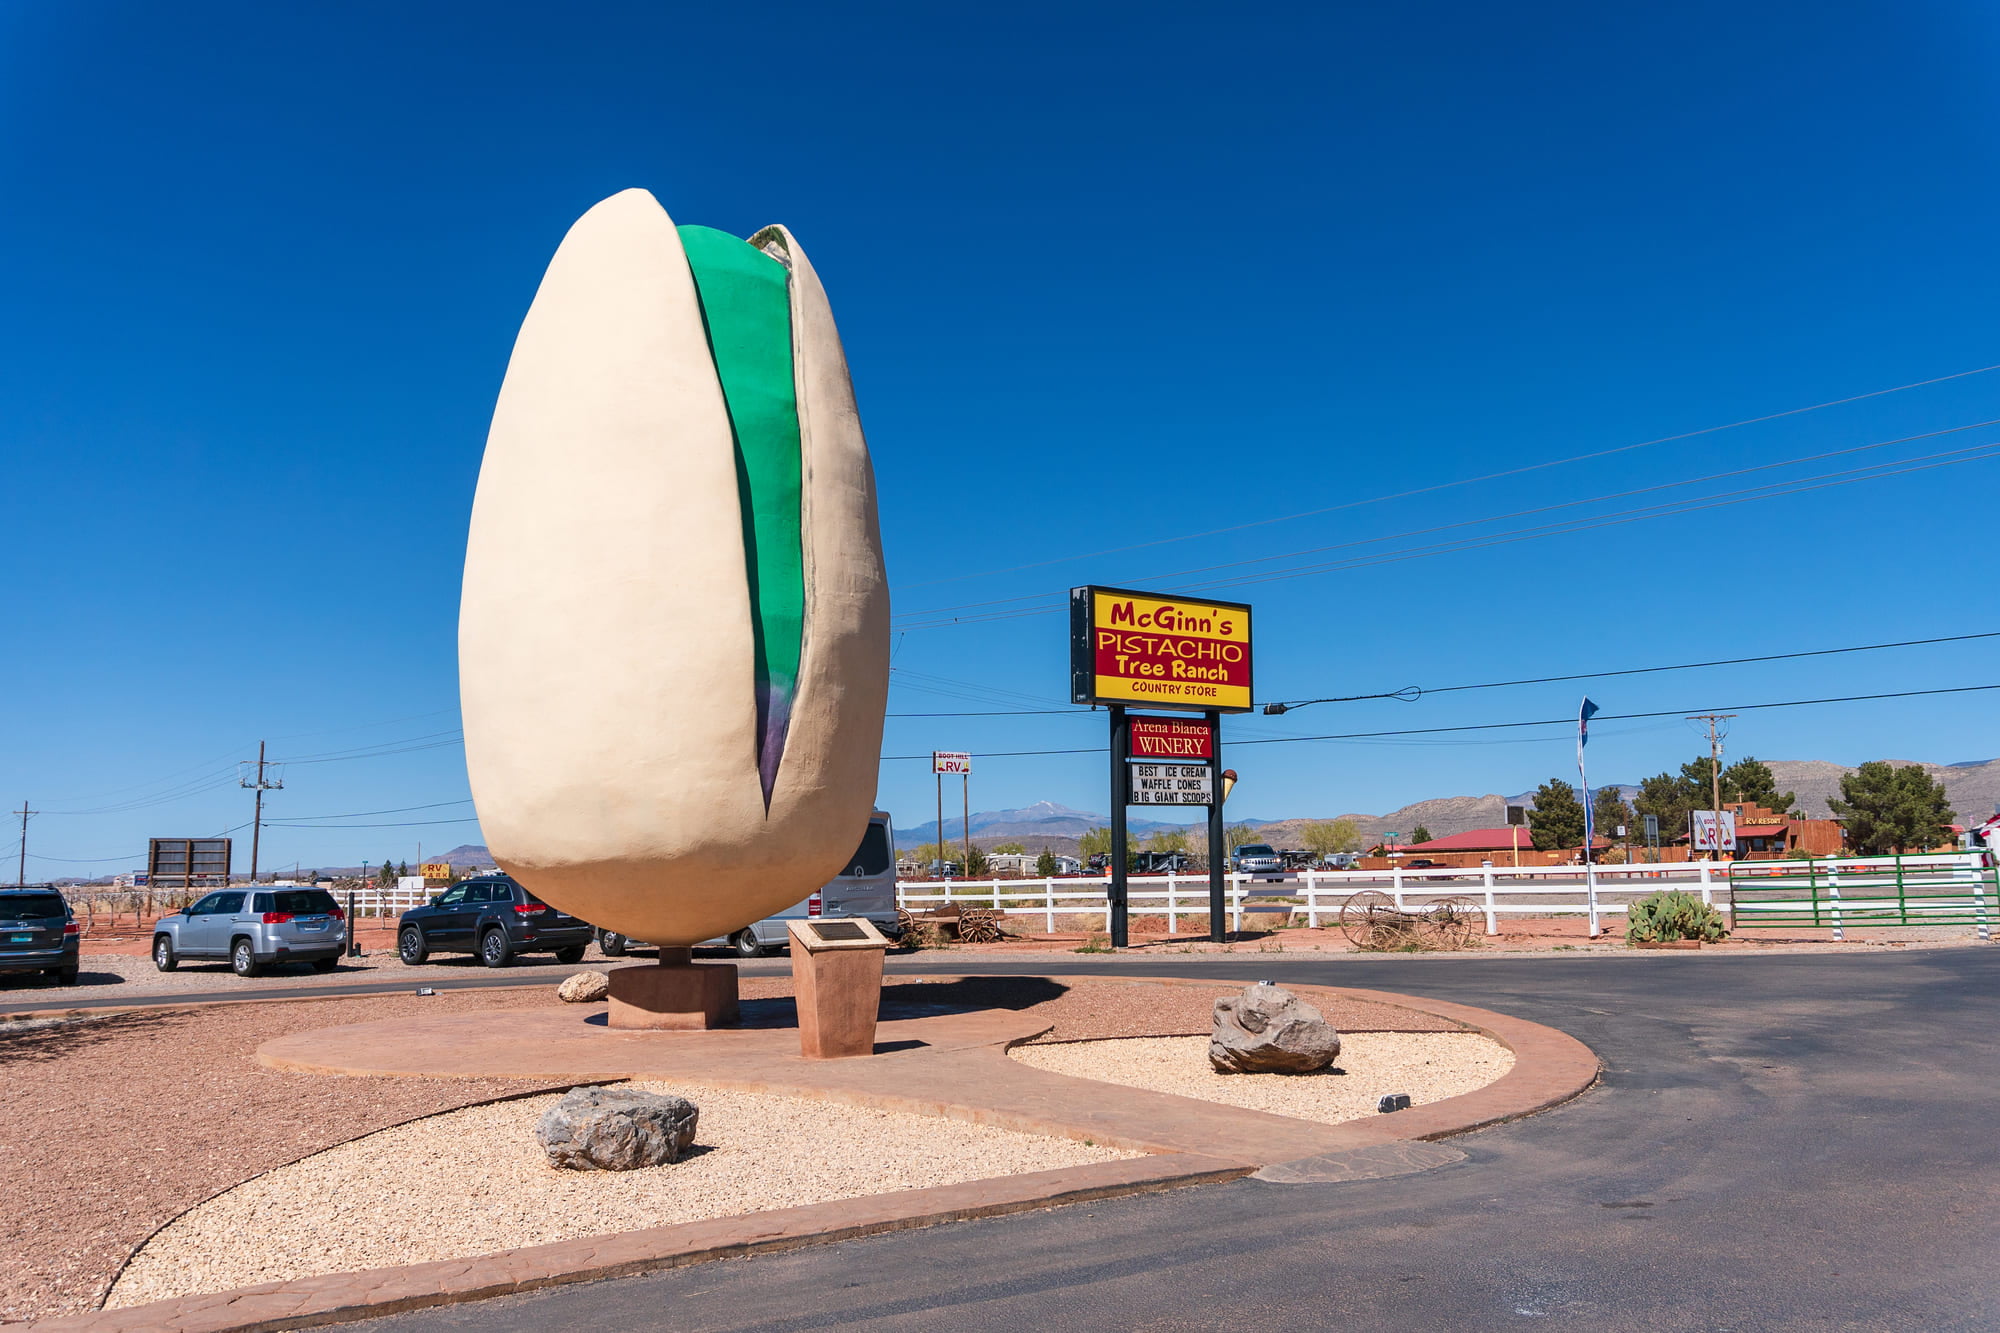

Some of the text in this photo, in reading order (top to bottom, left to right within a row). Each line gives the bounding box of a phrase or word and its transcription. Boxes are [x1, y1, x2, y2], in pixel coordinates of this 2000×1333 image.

[1110, 601, 1233, 635] McGinn's
[1098, 632, 1243, 663] PISTACHIO
[1115, 655, 1229, 681] Tree Ranch
[1132, 681, 1217, 697] COUNTRY STORE
[1133, 720, 1209, 735] Arena Blanca
[1139, 736, 1205, 755] WINERY
[945, 761, 961, 772] RV
[1138, 766, 1207, 778] BEST ICE CREAM
[1141, 779, 1202, 790] WAFFLE CONES
[1134, 791, 1211, 803] BIG GIANT SCOOPS
